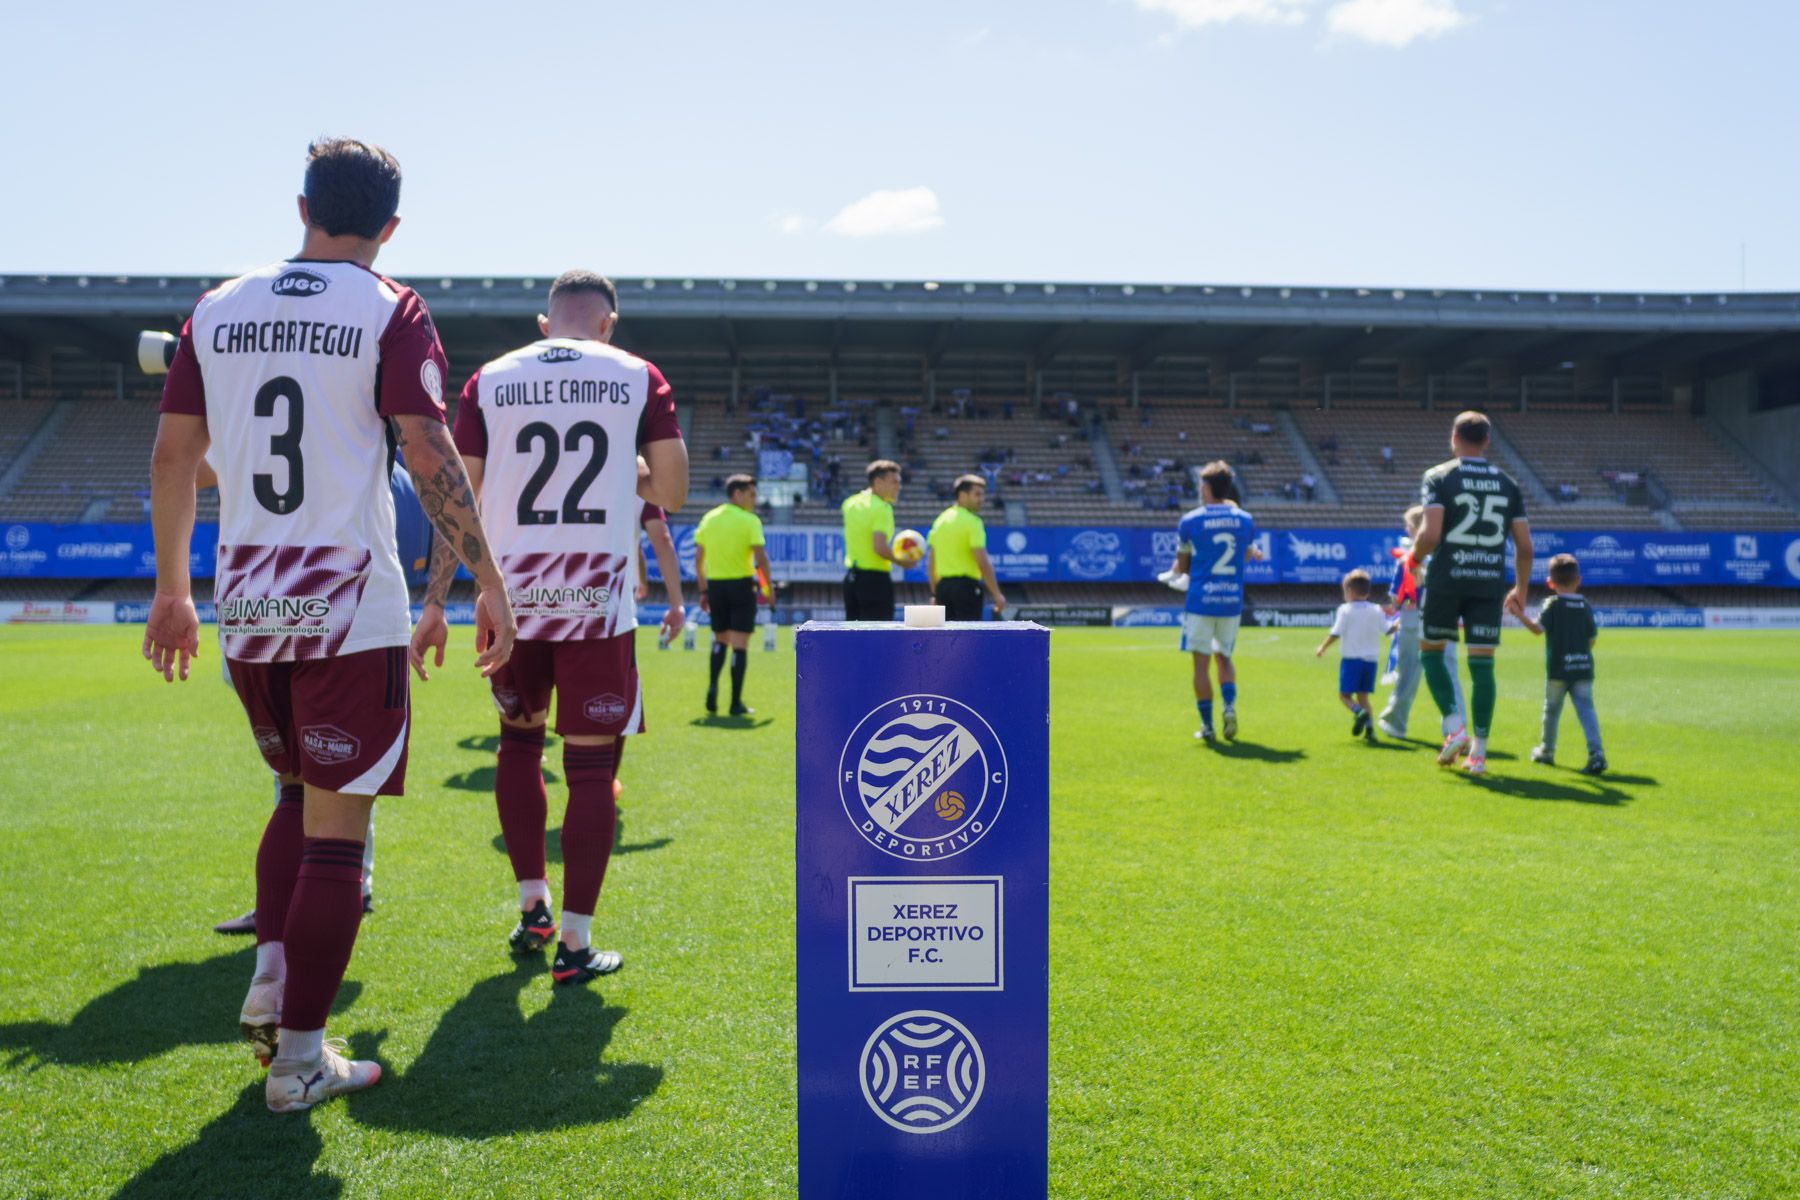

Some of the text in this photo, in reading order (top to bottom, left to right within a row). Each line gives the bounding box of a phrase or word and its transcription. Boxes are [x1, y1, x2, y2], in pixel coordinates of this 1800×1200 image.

[274, 277, 326, 293] LUGO
[213, 320, 363, 359] CHACARTEGUI
[540, 348, 581, 361] LUGO
[495, 379, 630, 407] GUILLE CAMPOS
[252, 375, 305, 515] 3
[516, 420, 609, 526] 22
[1446, 492, 1509, 547] 25
[1211, 532, 1237, 576] 2
[1273, 611, 1333, 626] hummel
[239, 625, 275, 634] Aplicadora
[277, 625, 329, 635] Homologada
[900, 700, 946, 714] 1911
[845, 771, 853, 782] F
[885, 735, 961, 824] XEREZ
[991, 772, 1003, 784] C
[862, 820, 983, 856] DEPORTIVO
[893, 904, 958, 919] XEREZ
[867, 926, 984, 941] DEPORTIVO
[908, 948, 943, 963] F.C.
